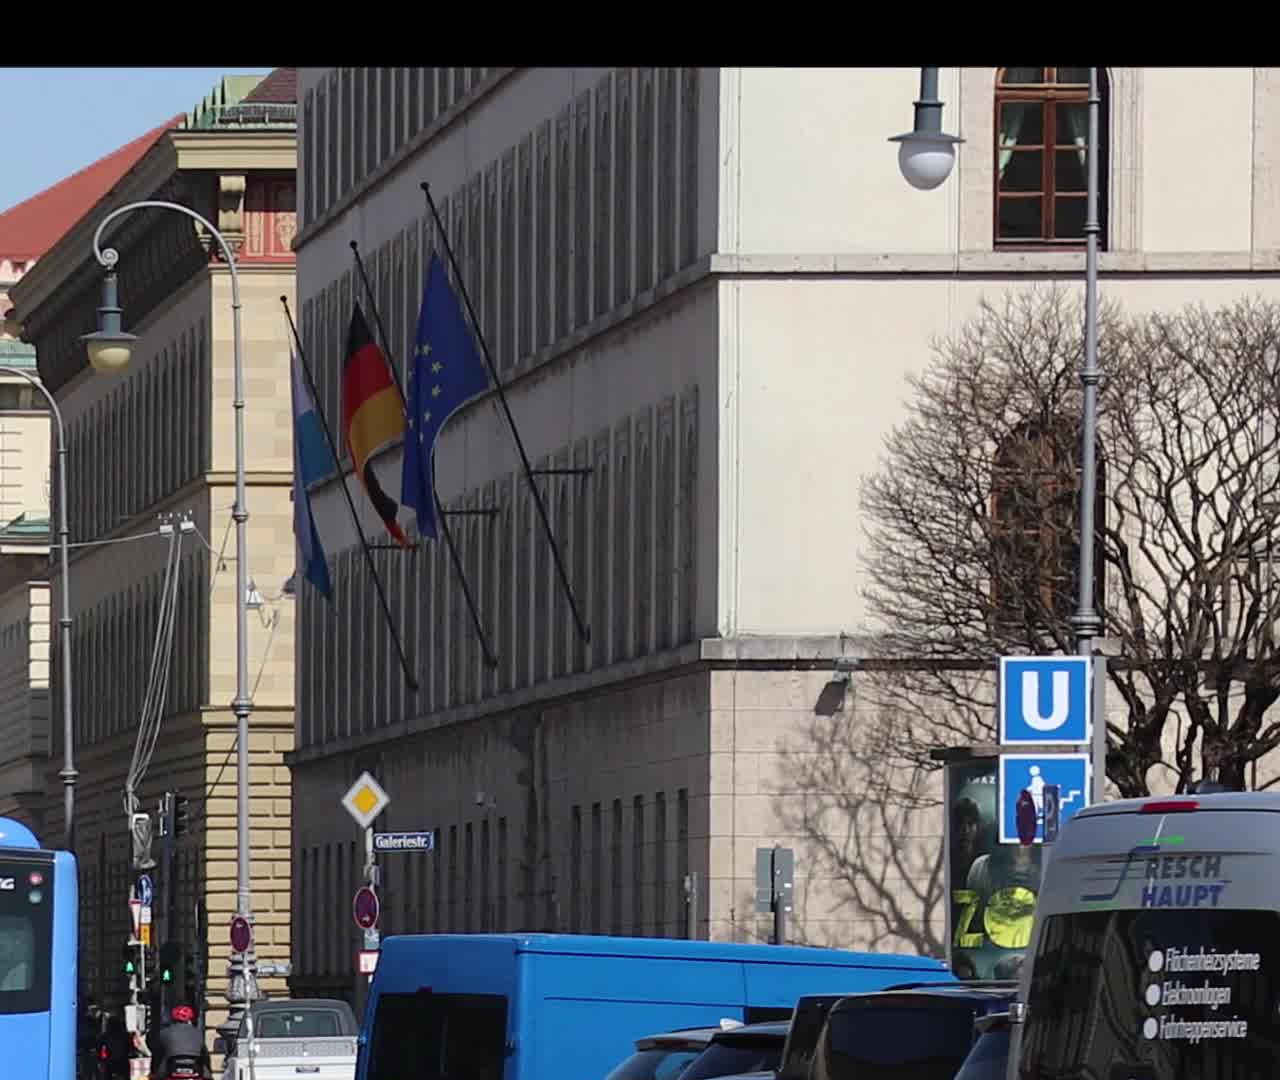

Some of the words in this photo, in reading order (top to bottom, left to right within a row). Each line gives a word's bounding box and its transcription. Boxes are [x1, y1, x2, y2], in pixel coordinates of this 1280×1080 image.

[1022, 670, 1070, 732] U
[375, 835, 428, 849] Galeriestr.
[1144, 855, 1222, 879] RESCH
[1141, 884, 1224, 907] HAUPT
